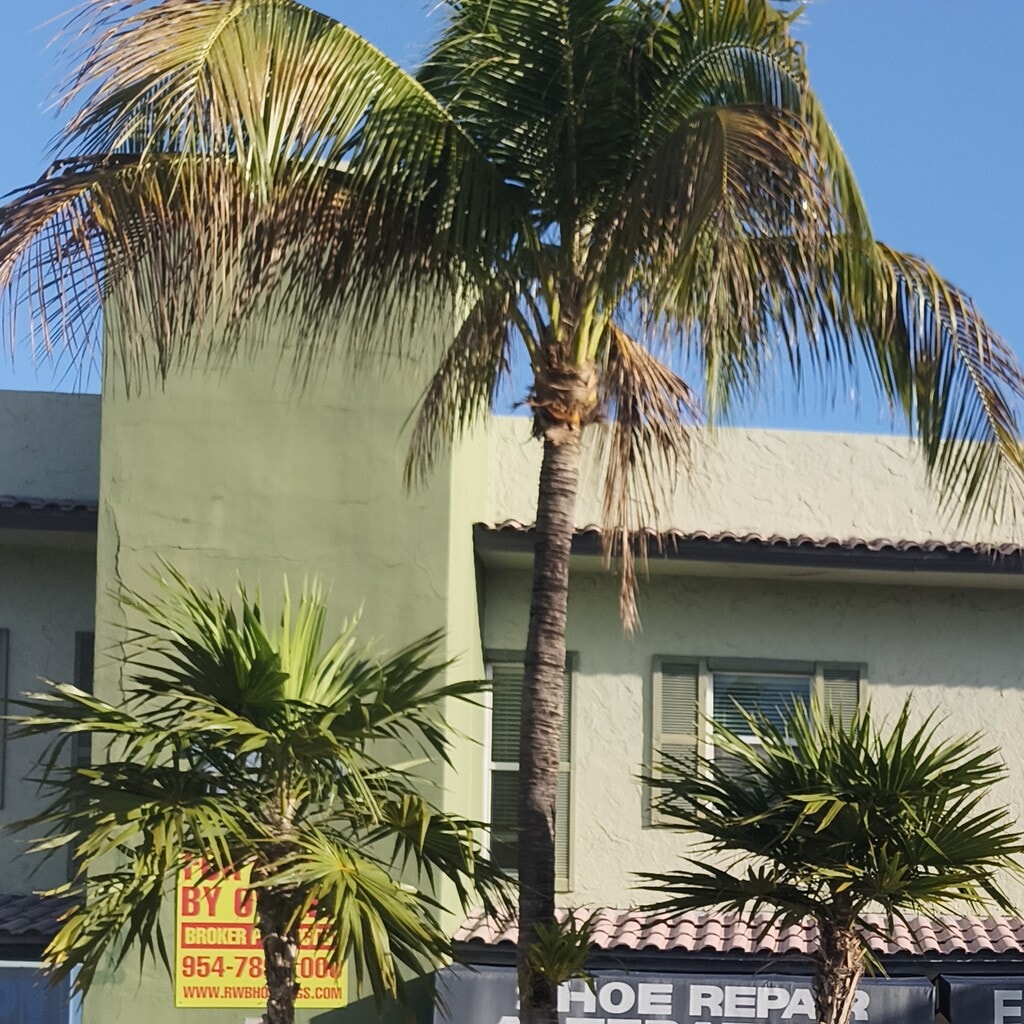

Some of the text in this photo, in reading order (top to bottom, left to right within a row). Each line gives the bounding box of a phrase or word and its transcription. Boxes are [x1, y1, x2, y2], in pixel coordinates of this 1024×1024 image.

[182, 886, 222, 917] BY
[185, 927, 247, 945] BROKER
[516, 981, 870, 1021] HOE REPAR
